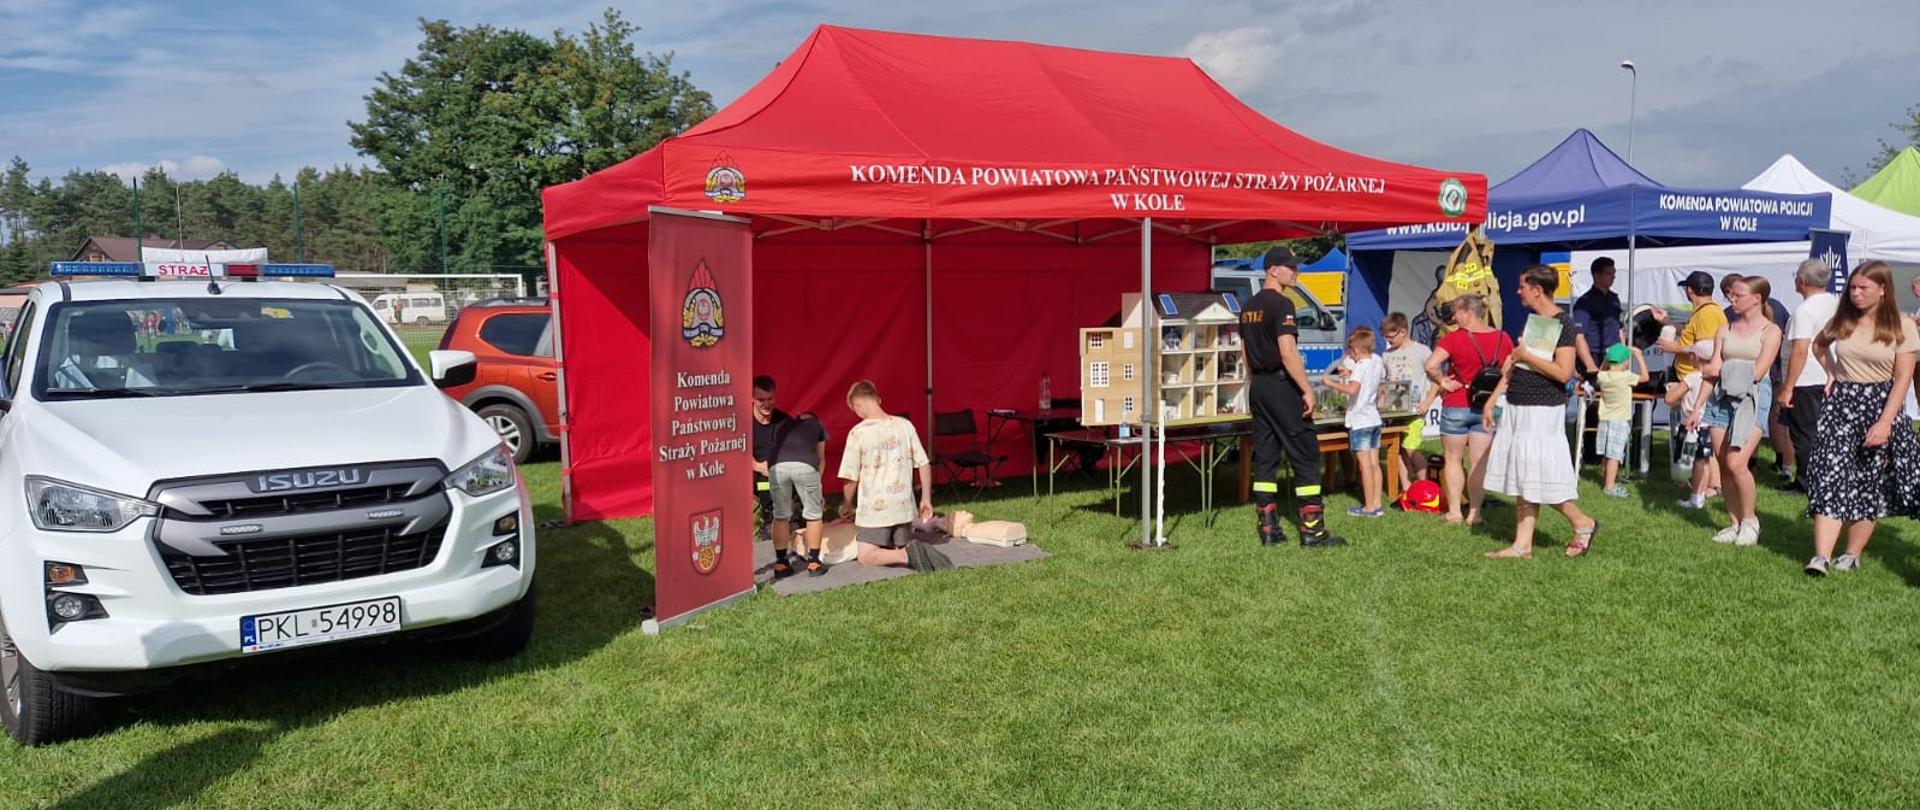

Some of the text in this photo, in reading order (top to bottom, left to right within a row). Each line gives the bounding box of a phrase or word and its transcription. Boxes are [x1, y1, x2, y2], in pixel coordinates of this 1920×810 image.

[850, 164, 1386, 194] KOMENDA POWIATOWA PAŃSTWOWEJ STRAŻY POŻARNEJ
[1110, 193, 1185, 211] W KOLE
[1659, 194, 1813, 216] KOMENDA POWIATOWA POLICJI
[1720, 216, 1758, 232] W KOLE
[677, 369, 731, 388] Komenda
[674, 394, 734, 412] Powiatowa
[672, 413, 736, 436] Państwowej
[659, 433, 746, 462] Straży Pożarnej
[257, 468, 361, 492] ISUZU
[686, 460, 725, 480] w Kole
[258, 602, 397, 642] PKL 54998
